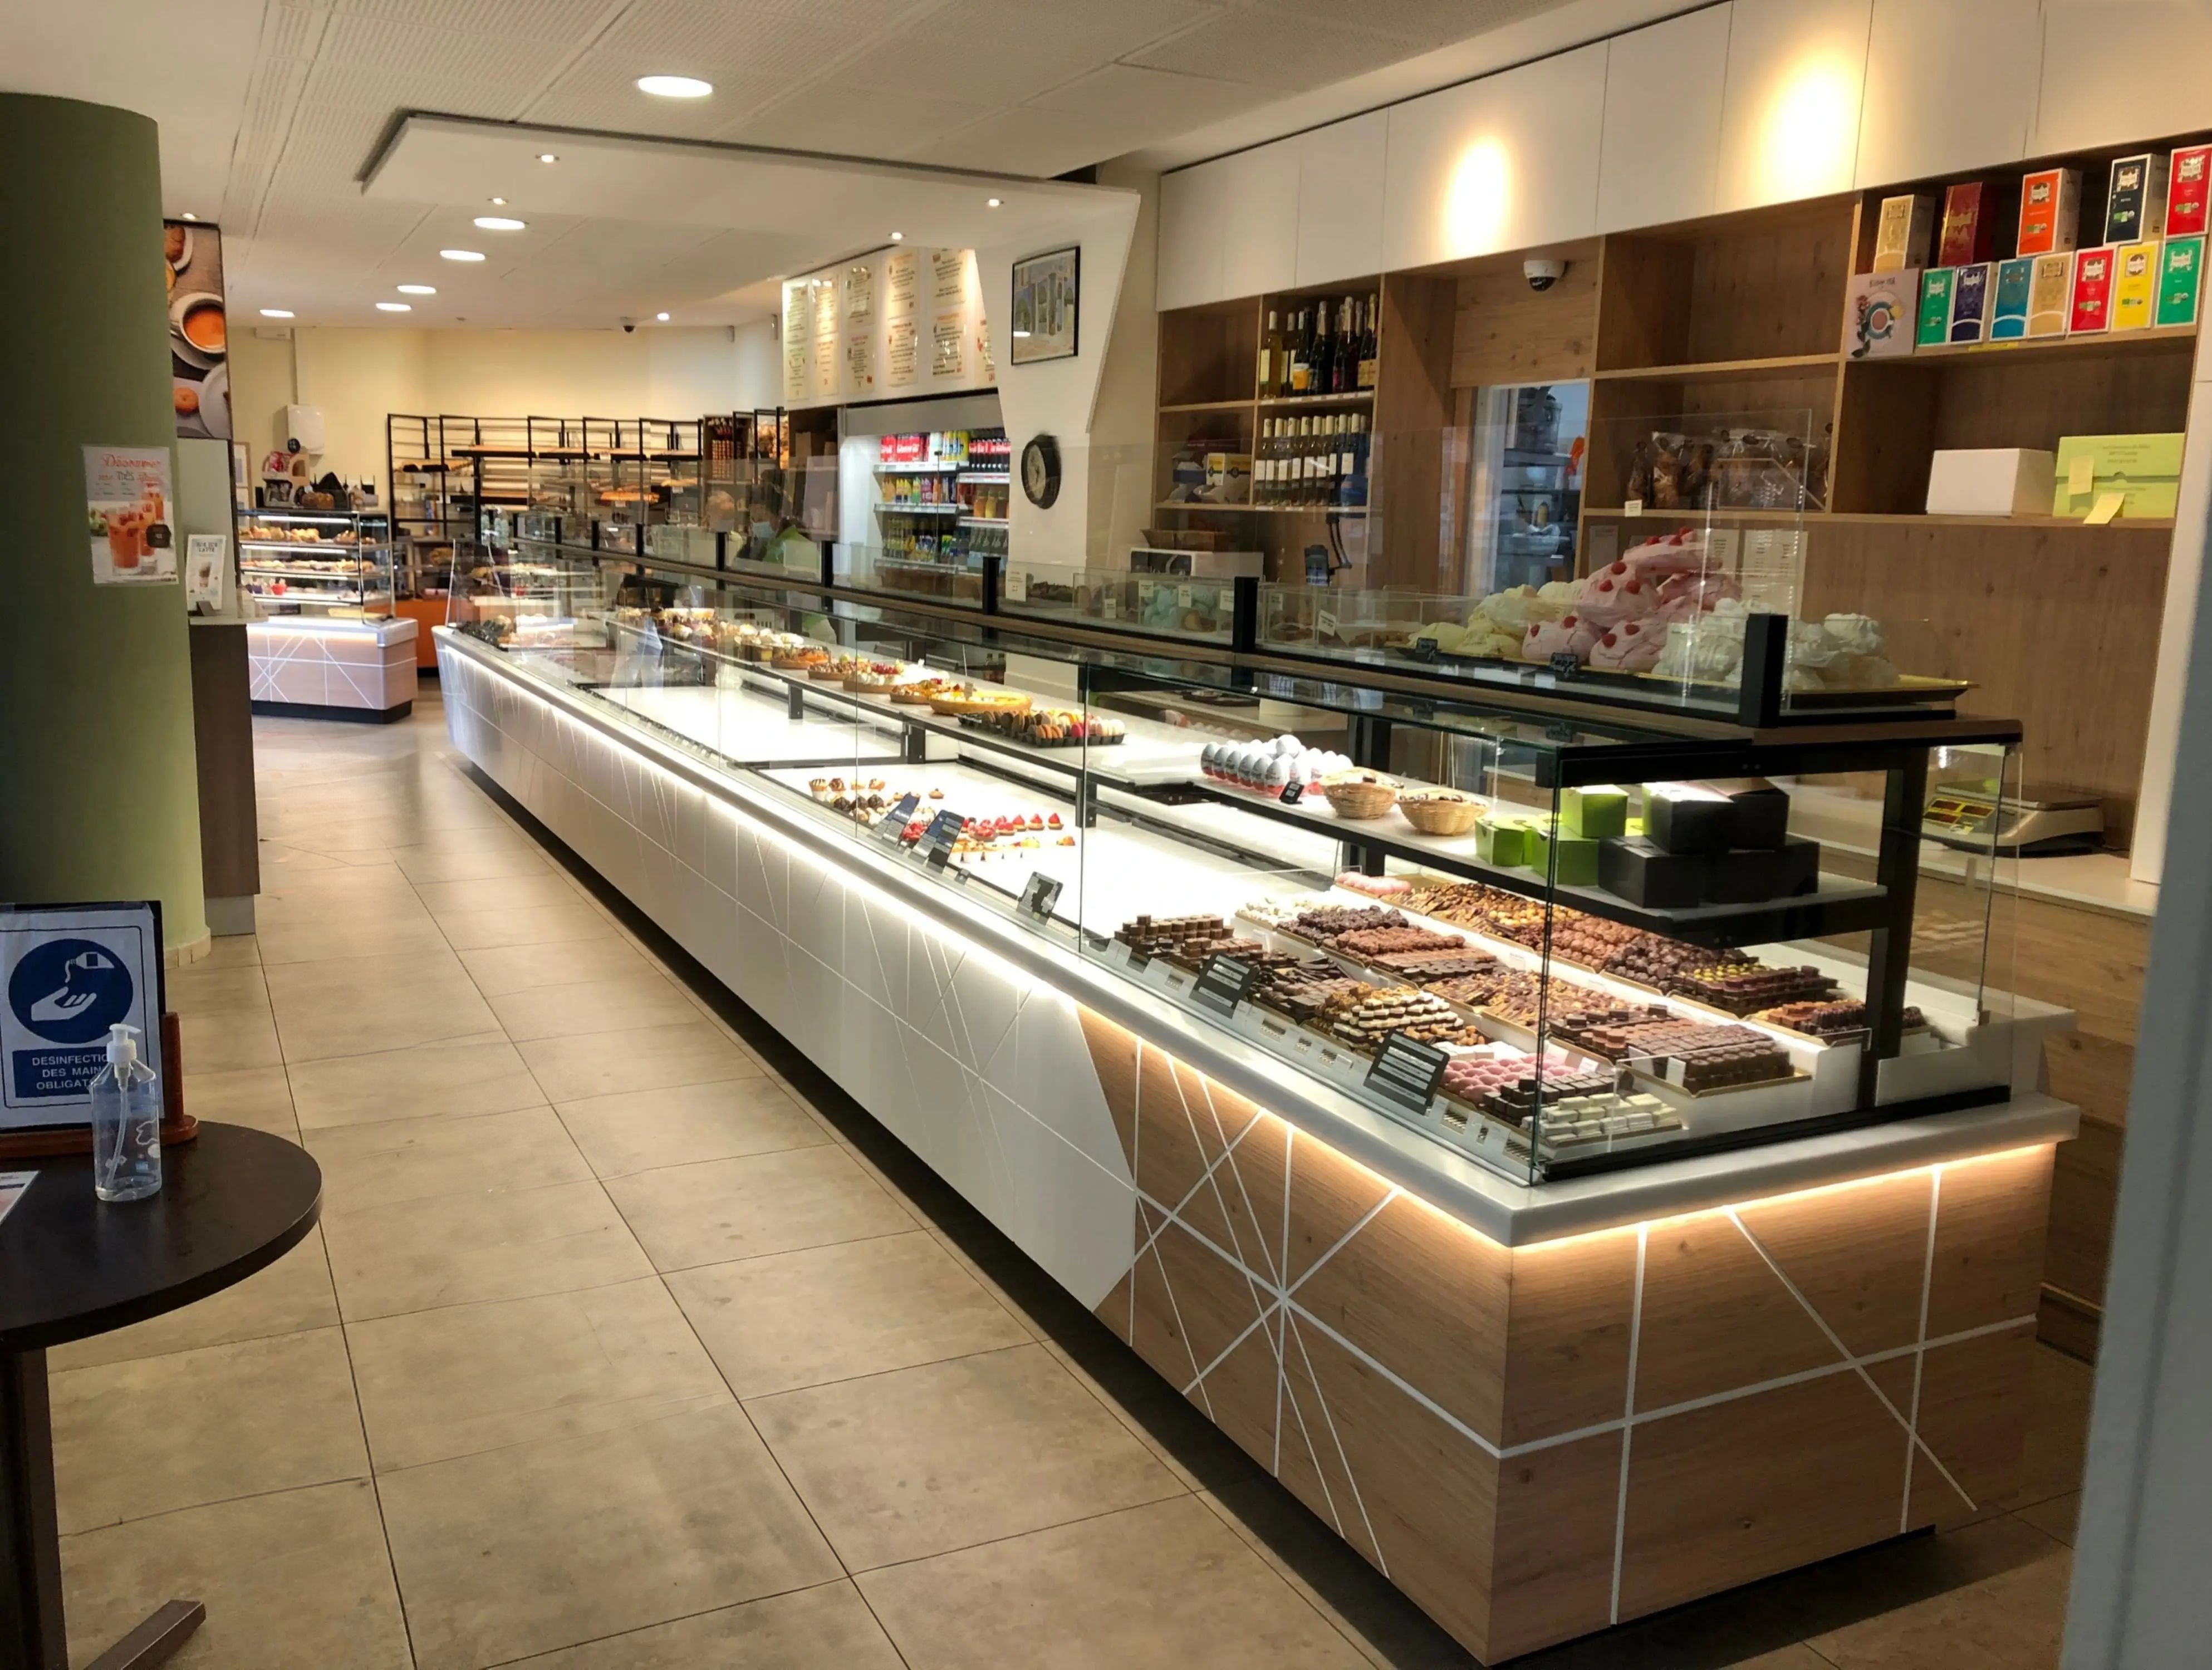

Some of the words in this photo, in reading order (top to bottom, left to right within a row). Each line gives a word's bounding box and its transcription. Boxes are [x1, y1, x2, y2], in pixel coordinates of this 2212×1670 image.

[32, 1054, 107, 1066] DESINFECTIO
[42, 1068, 66, 1078] DES
[72, 1067, 101, 1075] MAIN
[36, 1079, 90, 1090] OBLIGAT
